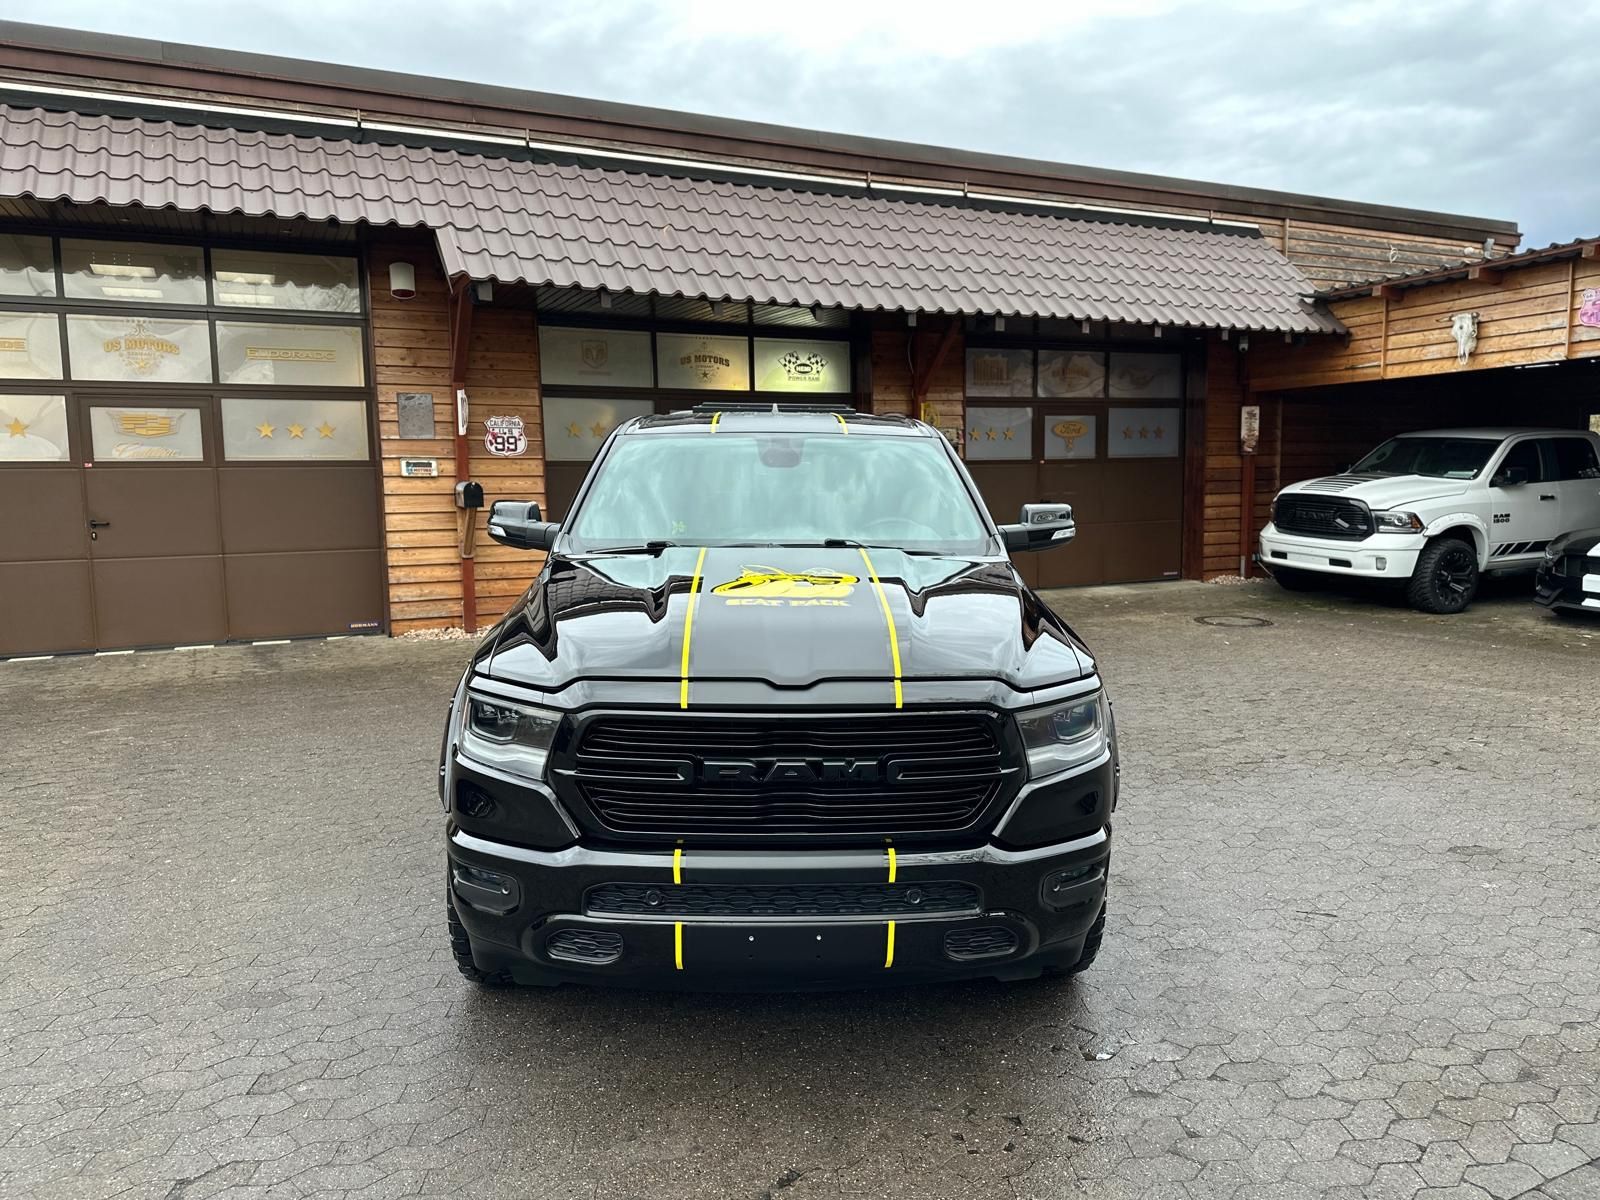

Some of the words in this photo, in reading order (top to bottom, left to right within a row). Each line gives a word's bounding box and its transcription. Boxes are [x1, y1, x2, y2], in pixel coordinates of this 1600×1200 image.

[103, 340, 121, 352] US
[125, 336, 180, 355] MOTORS
[680, 355, 692, 365] US
[694, 354, 730, 367] MOTORS
[490, 419, 521, 427] CALIFORNIA
[1060, 423, 1082, 434] Ford
[495, 435, 517, 452] 99
[788, 599, 851, 607] PACK
[703, 757, 880, 783] RAM
